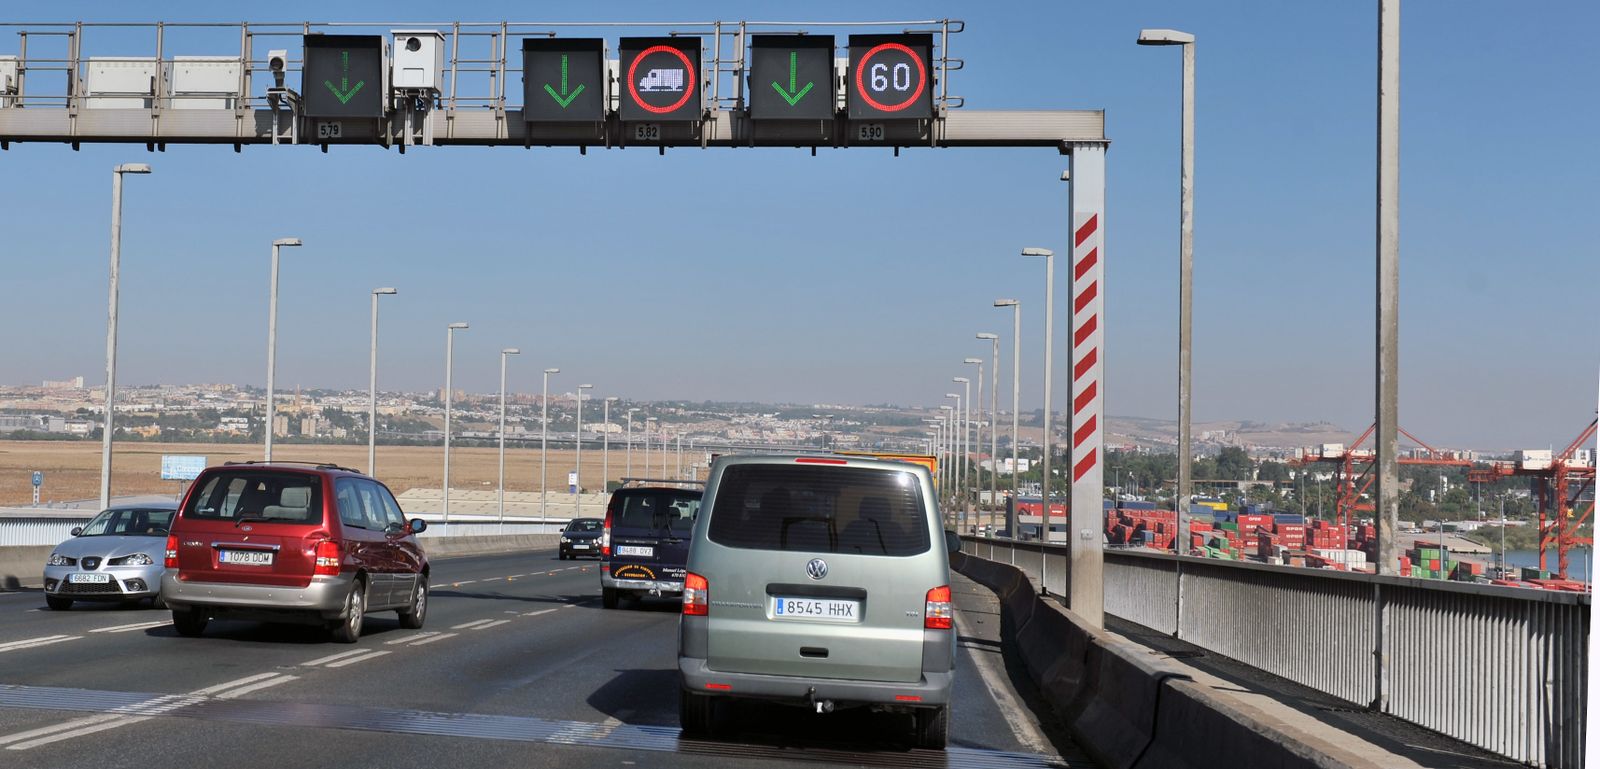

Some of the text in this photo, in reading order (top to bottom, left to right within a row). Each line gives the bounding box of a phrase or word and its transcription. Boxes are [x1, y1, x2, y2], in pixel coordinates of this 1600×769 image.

[872, 63, 910, 91] 60
[321, 125, 339, 136] 5,79
[230, 552, 250, 562] 1078
[787, 601, 853, 617] 8545 HHX
